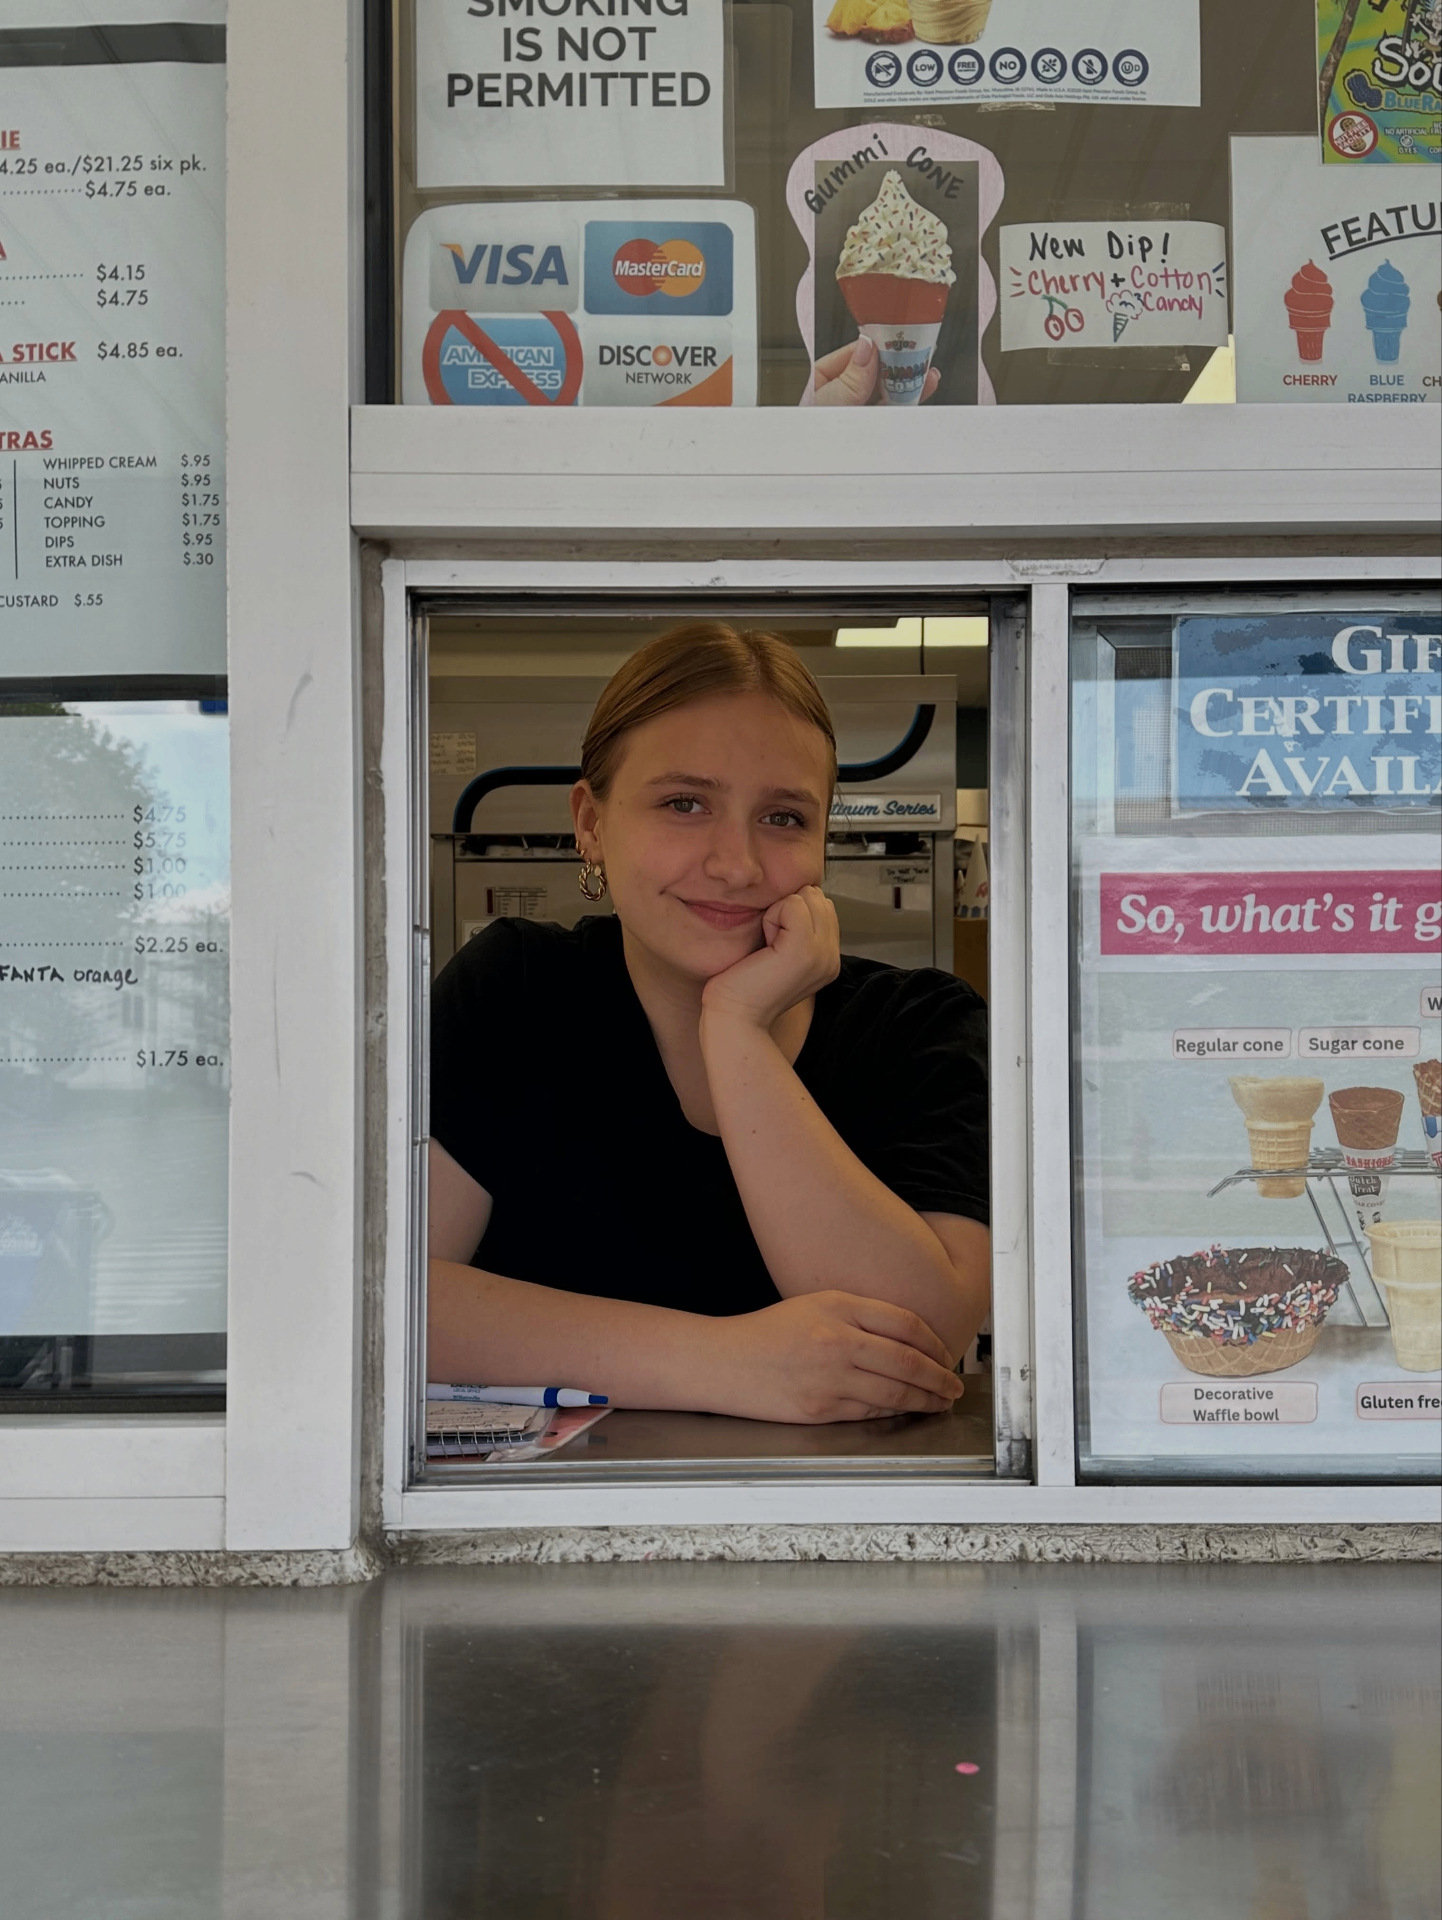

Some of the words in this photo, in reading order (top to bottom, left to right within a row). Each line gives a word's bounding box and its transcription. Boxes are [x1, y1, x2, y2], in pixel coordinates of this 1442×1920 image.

[502, 27, 543, 62] IS
[557, 27, 657, 61] NOT
[915, 63, 936, 72] LOW
[957, 61, 976, 69] FREE
[999, 61, 1017, 70] NO
[447, 71, 711, 108] PERMITTED
[150, 155, 173, 171] six
[180, 154, 207, 175] pk.
[85, 180, 138, 200] $4.75
[144, 183, 171, 197] ea.
[1320, 201, 1441, 255] FEATU
[1029, 231, 1086, 262] New
[1107, 230, 1170, 264] Dip!
[96, 263, 146, 283] $4.15
[439, 243, 570, 286] VISA
[614, 259, 705, 278] MasterCard
[1028, 268, 1106, 299] Cherry
[1130, 264, 1213, 295] Cotton
[96, 289, 149, 309] $4.75
[1142, 291, 1204, 319] Candy
[12, 341, 77, 363] STICK
[97, 340, 150, 361] $4.85
[156, 345, 183, 358] ea.
[599, 345, 718, 367] DISCOVER
[625, 372, 692, 385] NETWORK
[1283, 374, 1338, 386] CHERRY
[1369, 374, 1405, 386] BLUE
[1347, 393, 1428, 404] RASPBERRY
[43, 457, 104, 470] WHIPPED
[108, 455, 157, 469] CREAM
[180, 453, 211, 468] $.95
[43, 477, 80, 490] NUTS
[180, 473, 211, 488] $.95
[43, 496, 93, 509] CANDY
[181, 493, 220, 507] $1.75
[44, 515, 106, 529] TOPPING
[181, 512, 221, 527] $1.75
[44, 536, 75, 548] DIPS
[182, 532, 213, 547] $.95
[45, 555, 87, 568] EXTRA
[91, 554, 123, 567] DISH
[183, 552, 214, 566] $.30
[74, 593, 103, 608] $.55
[1235, 748, 1441, 797] AVAIL
[133, 804, 187, 824] $4.75
[883, 800, 938, 815] Series
[133, 830, 187, 850] $5.75
[133, 856, 187, 876] $1.00
[133, 882, 187, 901] $1.00
[1116, 894, 1186, 944] So,
[1200, 892, 1355, 933] what's
[1368, 892, 1403, 932] it
[134, 935, 188, 955] $2.25
[196, 939, 223, 953] ea.
[0, 964, 65, 984] FANTA
[73, 967, 139, 991] orange
[1175, 1038, 1238, 1055] Regular
[1243, 1040, 1284, 1052] cone
[1308, 1037, 1358, 1055] Sugar
[1362, 1039, 1404, 1051] cone
[136, 1050, 188, 1069] $1.75
[196, 1054, 224, 1068] ea.
[1193, 1387, 1274, 1401] Decorative
[1360, 1395, 1413, 1409] Gluten
[1418, 1394, 1441, 1409] fre
[1193, 1408, 1238, 1421] Waffle
[1242, 1408, 1279, 1421] bowl
